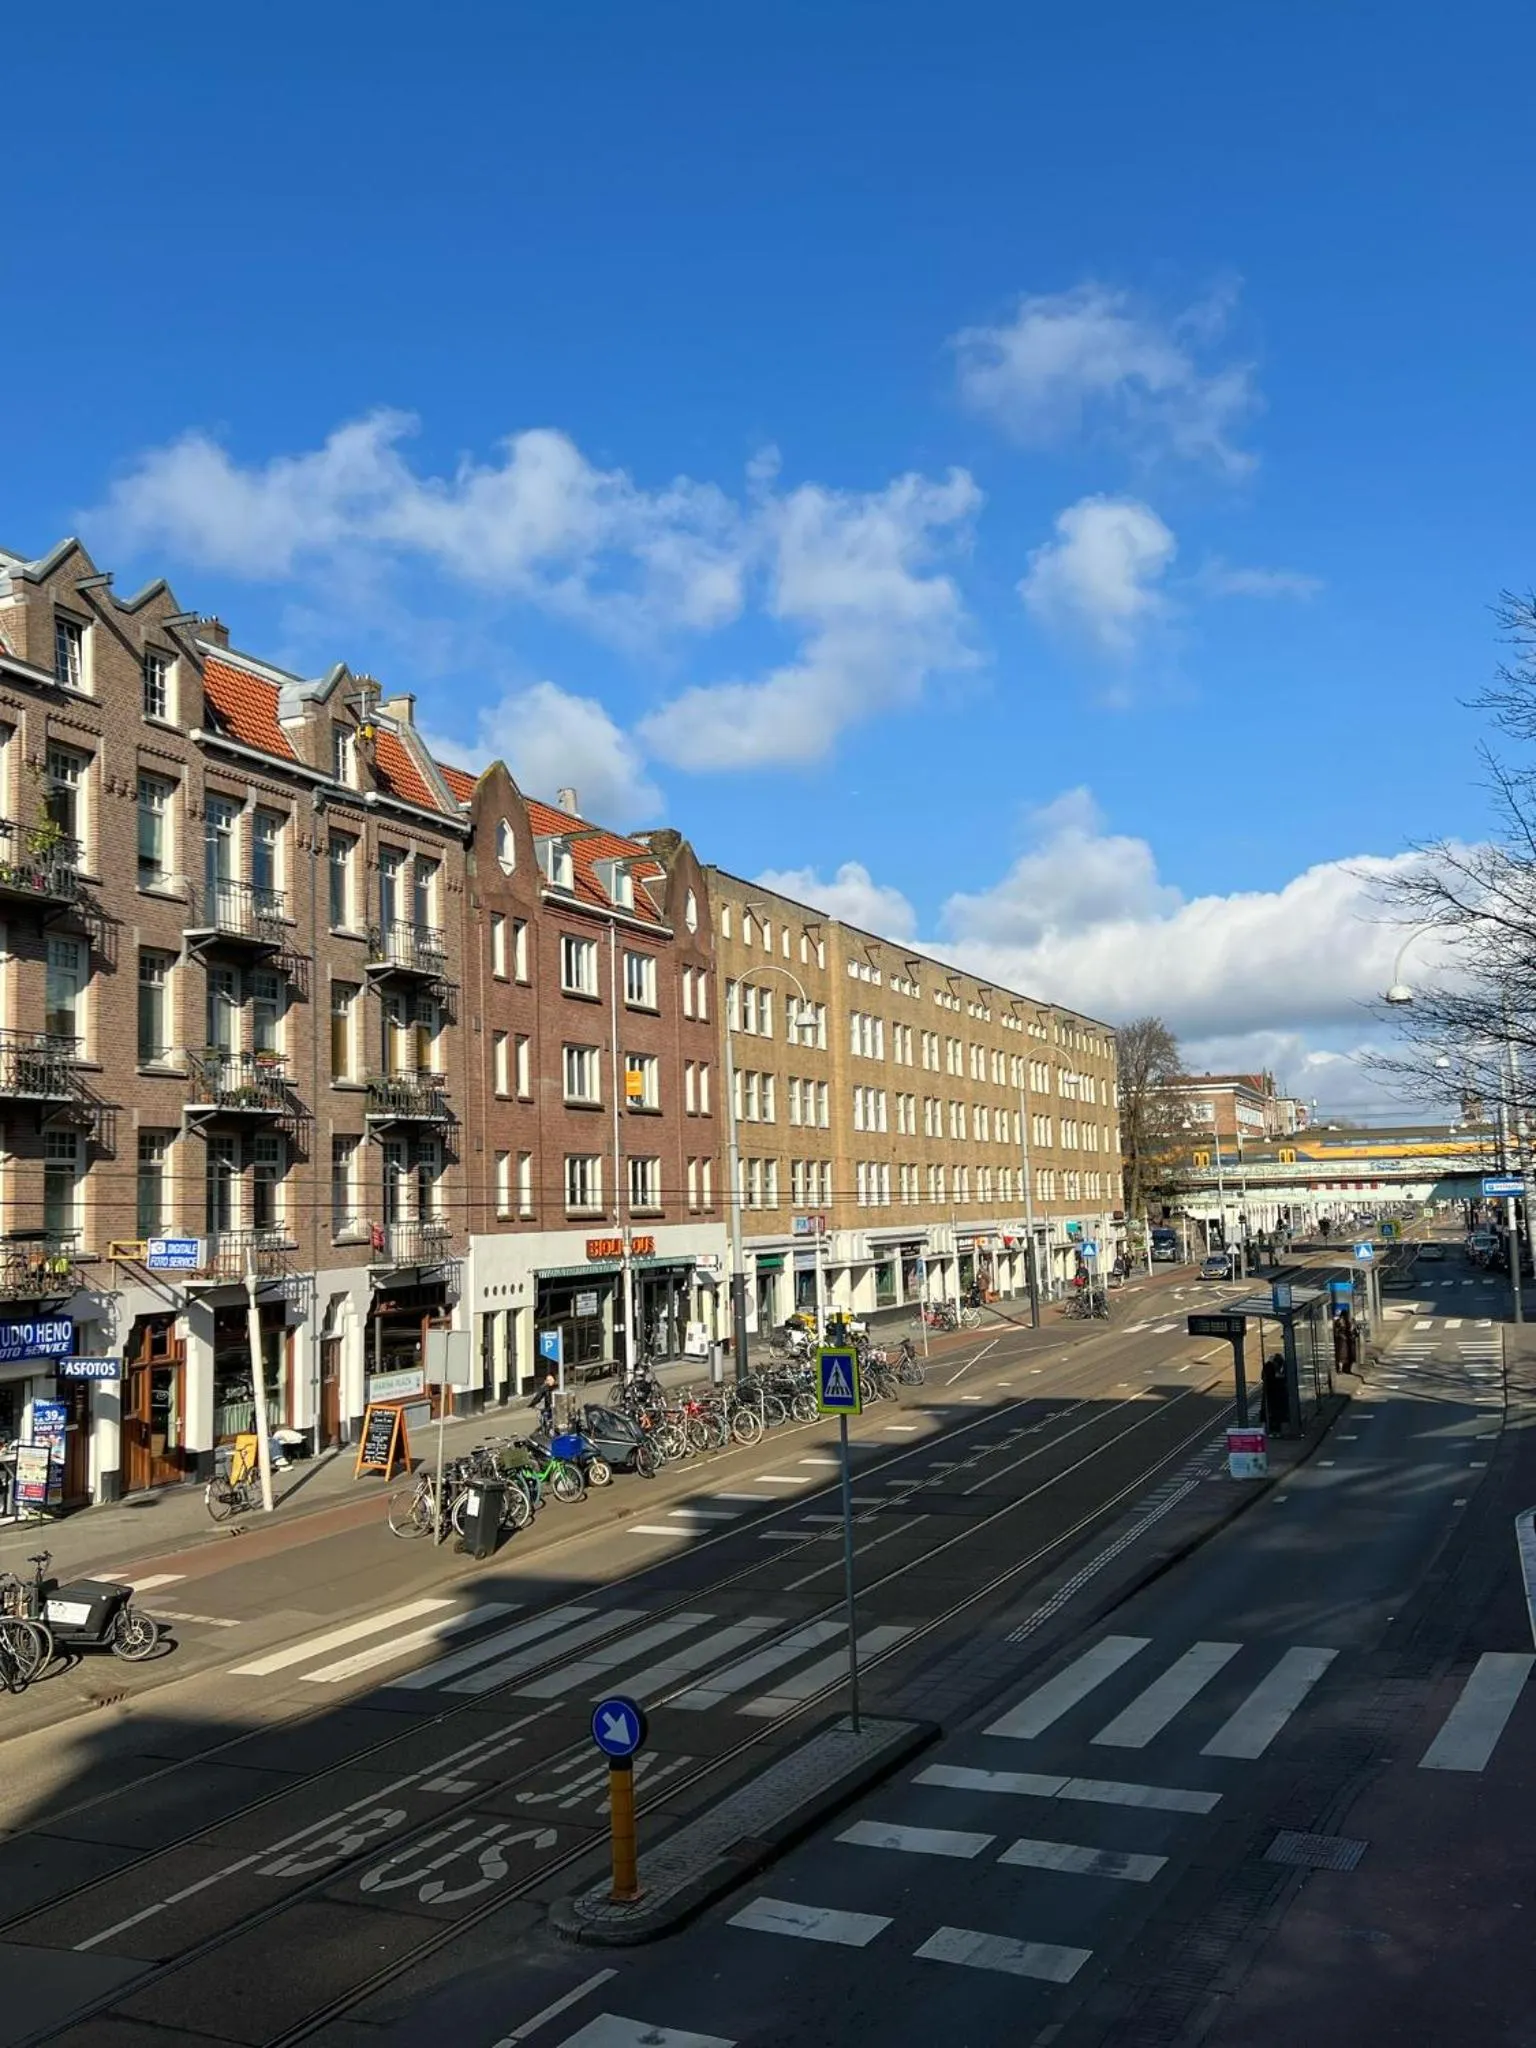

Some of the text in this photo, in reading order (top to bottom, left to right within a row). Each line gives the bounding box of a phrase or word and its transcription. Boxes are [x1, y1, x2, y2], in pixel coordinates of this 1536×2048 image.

[168, 1256, 198, 1268] SERVICE
[36, 1320, 72, 1343] HENO
[24, 1340, 70, 1357] SERVICE
[545, 1340, 554, 1353] P
[59, 1362, 116, 1376] PASFOTOS
[255, 1807, 558, 1905] BUS
